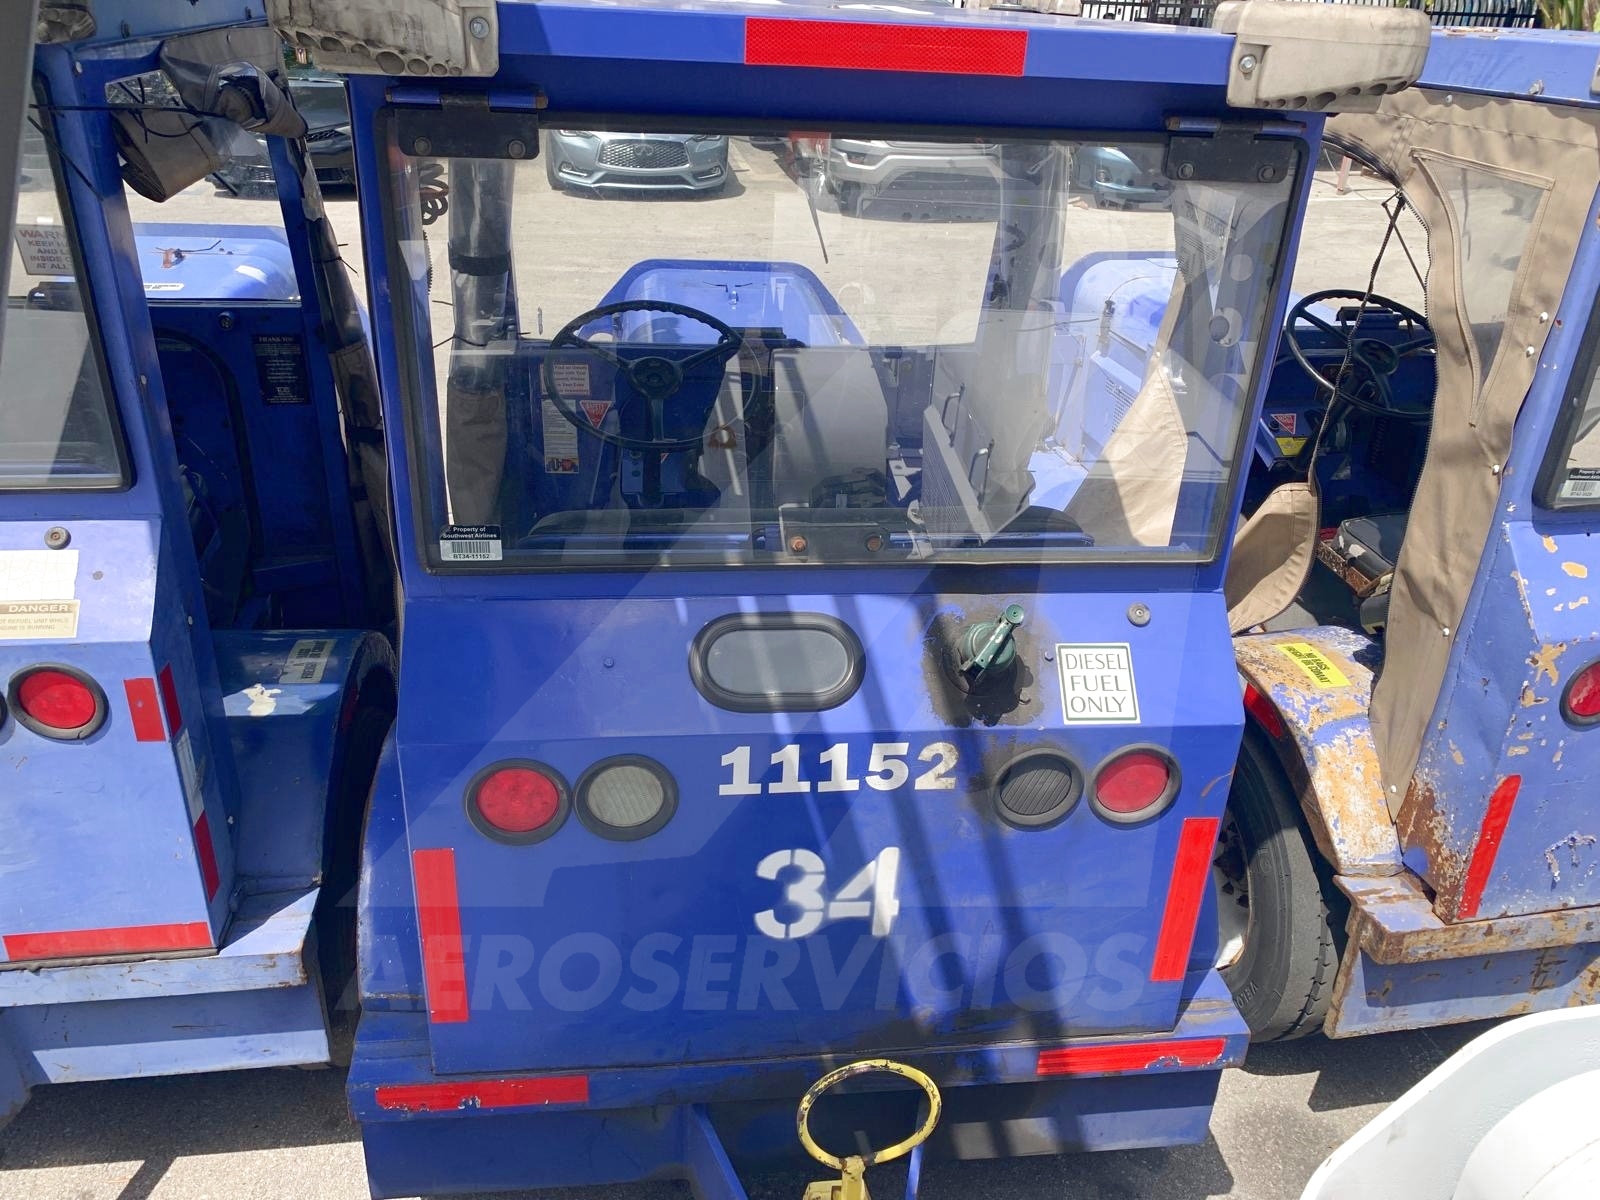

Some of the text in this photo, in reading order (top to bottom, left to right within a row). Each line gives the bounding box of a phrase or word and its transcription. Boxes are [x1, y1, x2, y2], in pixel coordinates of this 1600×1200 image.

[19, 229, 64, 240] WARN
[8, 604, 68, 613] DANGER
[1065, 653, 1127, 670] DIESEL
[1070, 675, 1127, 692] FUEL
[1070, 696, 1126, 713] ONLY
[718, 741, 959, 796] 11152
[753, 846, 901, 939] 34
